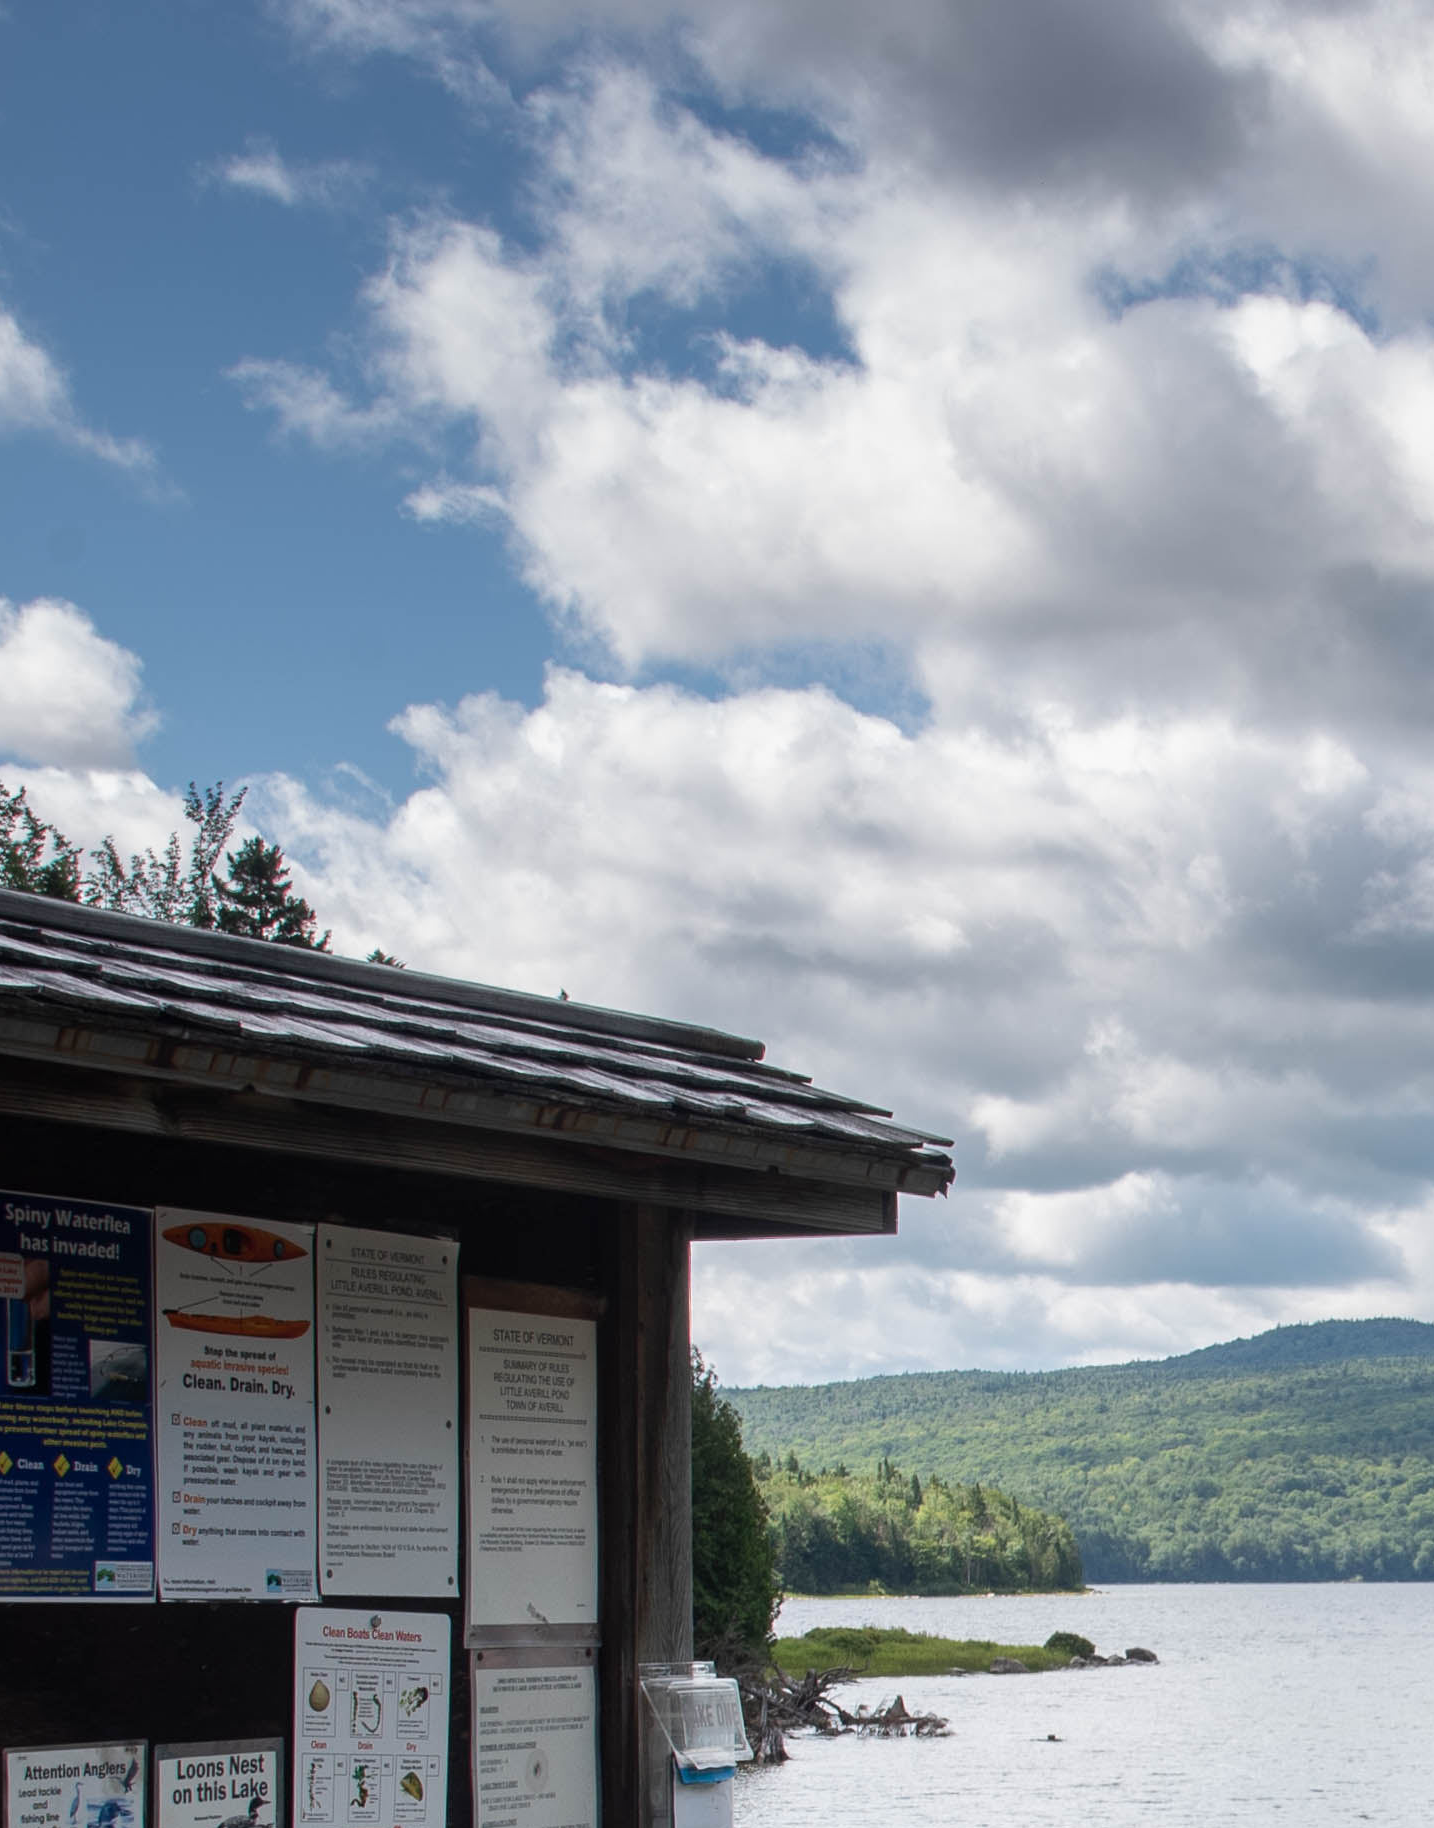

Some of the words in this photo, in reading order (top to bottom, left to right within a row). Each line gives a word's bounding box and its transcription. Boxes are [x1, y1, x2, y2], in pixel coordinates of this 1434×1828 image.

[5, 1203, 51, 1229] Spiny
[54, 1209, 131, 1235] Waterflea
[20, 1234, 49, 1252] has
[53, 1236, 120, 1260] invaded!
[351, 1248, 375, 1260] STATE
[377, 1250, 388, 1261] OF
[390, 1252, 425, 1264] VERMONT
[494, 1329, 521, 1342] STATE
[523, 1330, 534, 1344] OF
[537, 1332, 574, 1346] VERMONT
[204, 1345, 223, 1357] Stop
[225, 1347, 239, 1358] the
[240, 1348, 267, 1361] spread
[268, 1351, 276, 1361] of
[190, 1360, 221, 1370] aquatic
[224, 1361, 255, 1373] invasive
[258, 1364, 289, 1375] species!
[183, 1373, 226, 1391] Clean.
[230, 1377, 267, 1394] Drain.
[272, 1380, 295, 1397] Dry.
[507, 1400, 527, 1410] TOWN
[528, 1401, 537, 1410] OF
[539, 1402, 563, 1413] AVERILL
[183, 1417, 207, 1428] Clean
[17, 1458, 44, 1471] Clean
[73, 1461, 98, 1473] Drain
[126, 1464, 142, 1478] Dry
[184, 1494, 206, 1503] Drain
[182, 1525, 197, 1537] Dry
[323, 1626, 345, 1637] Clean
[347, 1628, 370, 1640] Boats
[372, 1629, 394, 1640] Clean
[396, 1631, 422, 1642] Waters
[691, 1704, 713, 1728] AKE
[24, 1763, 80, 1781] Attention
[83, 1762, 126, 1779] Anglers
[177, 1760, 224, 1780] Loons
[230, 1754, 264, 1776] Nest
[19, 1788, 36, 1797] Lead
[38, 1786, 61, 1796] tackle
[173, 1788, 192, 1804] on
[198, 1781, 226, 1802] this
[232, 1778, 268, 1799] Lake
[33, 1801, 48, 1810] and
[21, 1814, 44, 1824] fishing
[46, 1814, 60, 1822] line
